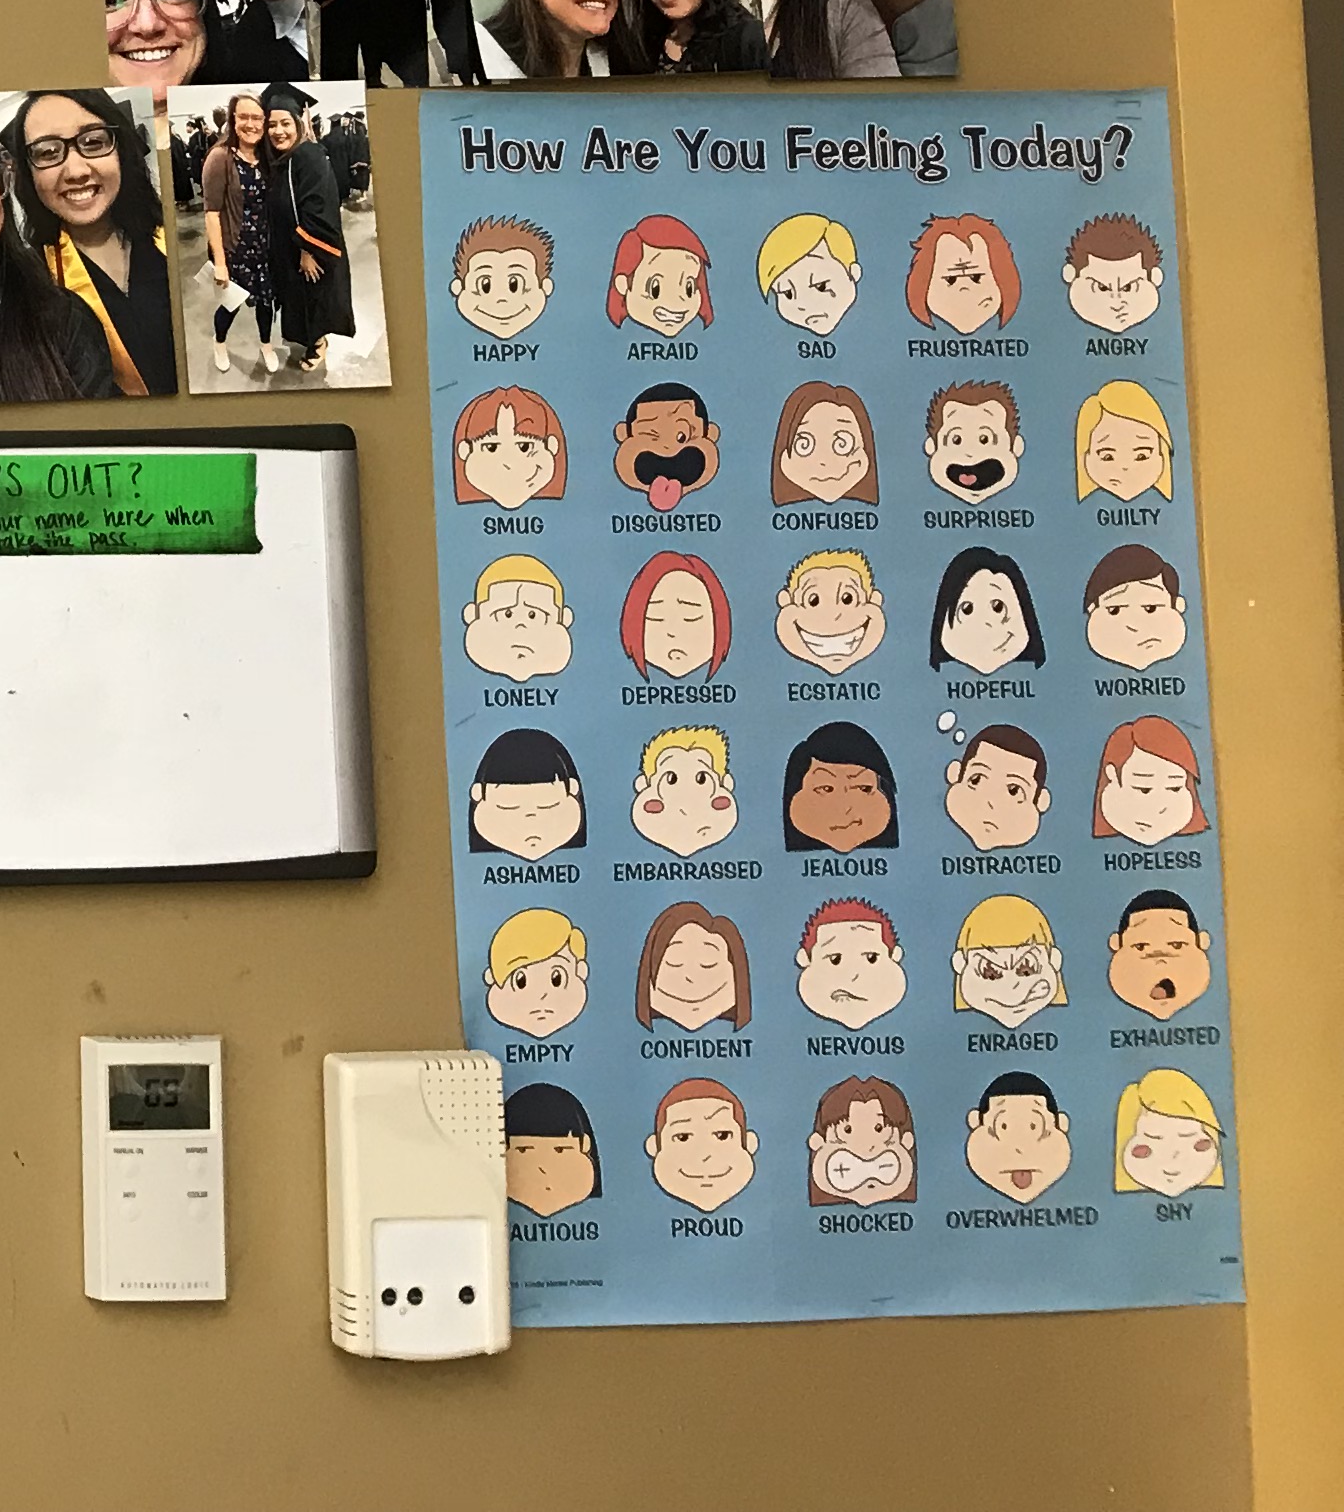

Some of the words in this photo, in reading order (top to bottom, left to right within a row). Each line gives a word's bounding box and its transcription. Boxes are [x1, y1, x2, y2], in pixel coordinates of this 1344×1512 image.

[461, 125, 564, 174] How
[581, 125, 659, 172] Are
[675, 125, 765, 172] You
[785, 124, 946, 183] Feeling
[962, 123, 1133, 183] Today?
[472, 343, 540, 362] HAPPY
[627, 342, 699, 361] AFRAID
[797, 340, 837, 359] SAD
[907, 338, 1029, 358] FRUSTRATED
[1085, 337, 1149, 357] ANGRY
[48, 462, 143, 499] OUT?
[35, 514, 89, 529] name
[104, 509, 153, 526] here
[166, 507, 214, 526] when
[483, 516, 544, 536] SMUG
[611, 513, 722, 534] DISGUSTED
[772, 511, 879, 531] CONFUSED
[923, 508, 1035, 529] SURPRISED
[1096, 507, 1161, 527] GUILTY
[621, 684, 737, 706] DEPRESSED
[787, 682, 881, 702] ECSTATIC
[946, 680, 1036, 700] HOPEFUL
[1094, 676, 1186, 697] WORRIED
[483, 687, 559, 708] LONELY
[613, 860, 763, 882] EMBARRASSED
[801, 857, 889, 878] JEALOUS
[941, 854, 1061, 876] DISTRACTED
[1103, 850, 1202, 872] HOPELESS
[483, 864, 581, 885] ASHAMED
[807, 1036, 905, 1057] NERVOUS
[967, 1032, 1059, 1053] ENRAGED
[1109, 1025, 1221, 1049] EXHAUSTED
[505, 1044, 575, 1064] EMPTY
[640, 1038, 753, 1060] CONFIDENT
[818, 1212, 914, 1235] SHOCKED
[946, 1206, 1098, 1231] OVERWHELMED
[1156, 1203, 1193, 1223] SHY
[509, 1222, 599, 1242] AUTIOUS
[671, 1217, 744, 1238] PROUD
